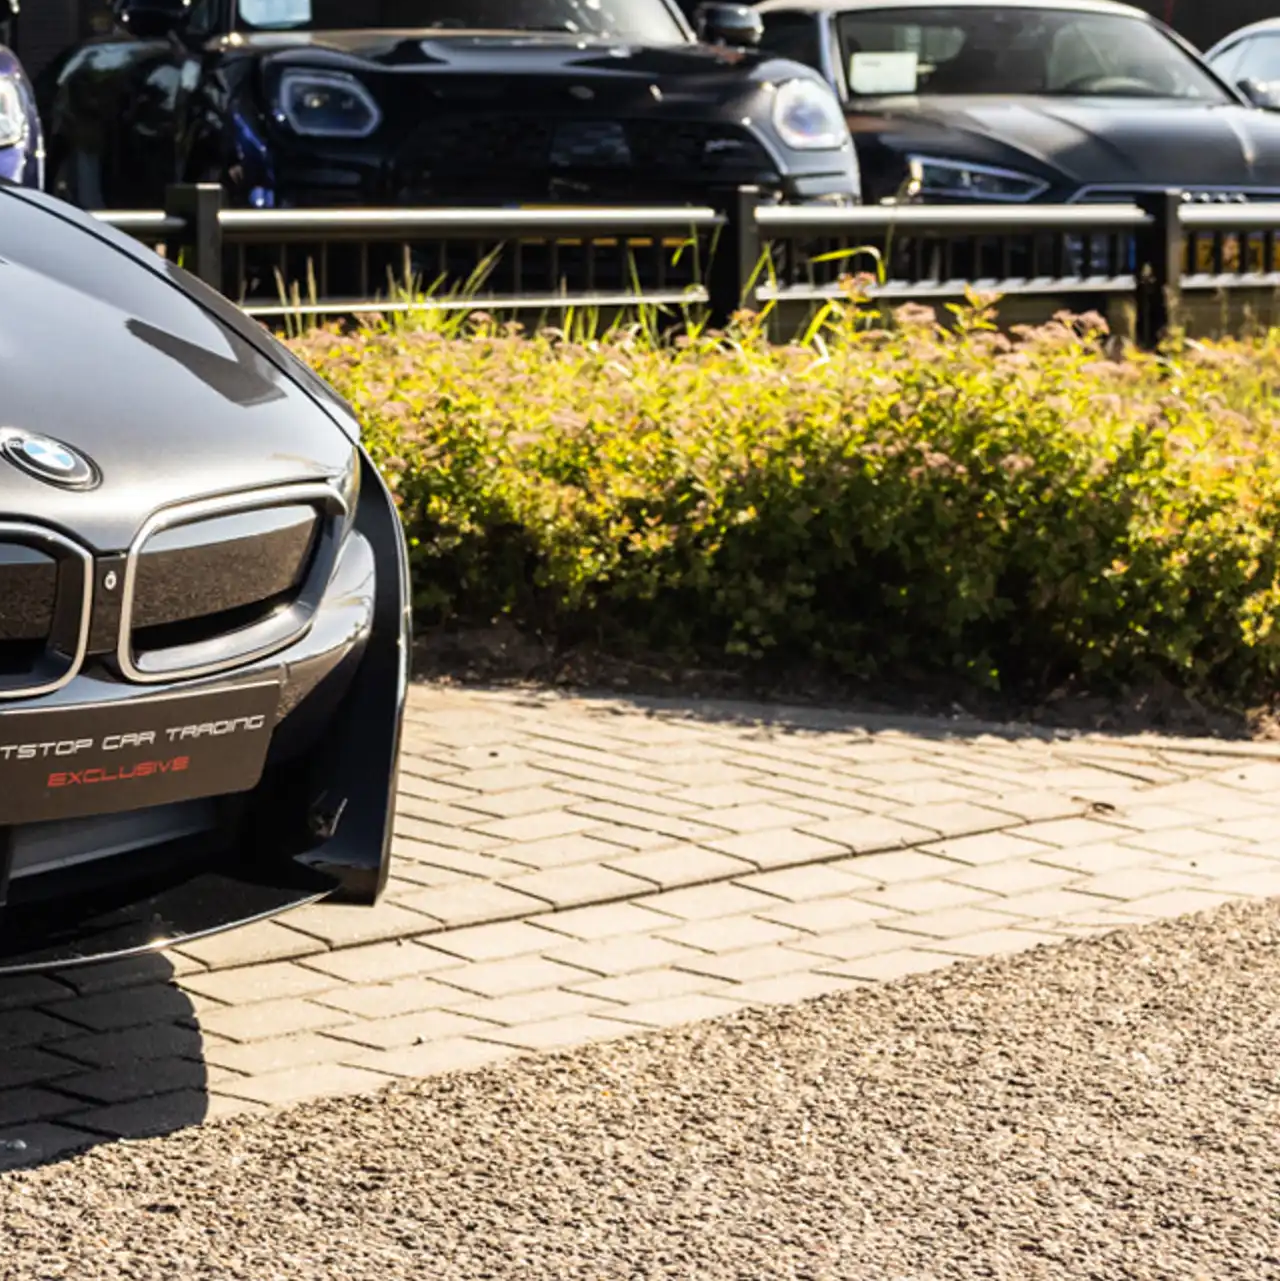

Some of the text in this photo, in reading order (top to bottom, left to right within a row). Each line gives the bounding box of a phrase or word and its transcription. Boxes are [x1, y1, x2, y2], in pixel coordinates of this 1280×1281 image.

[101, 730, 157, 751] CAR
[165, 714, 266, 742] TRADING
[46, 755, 190, 788] EXCLUSIVE
